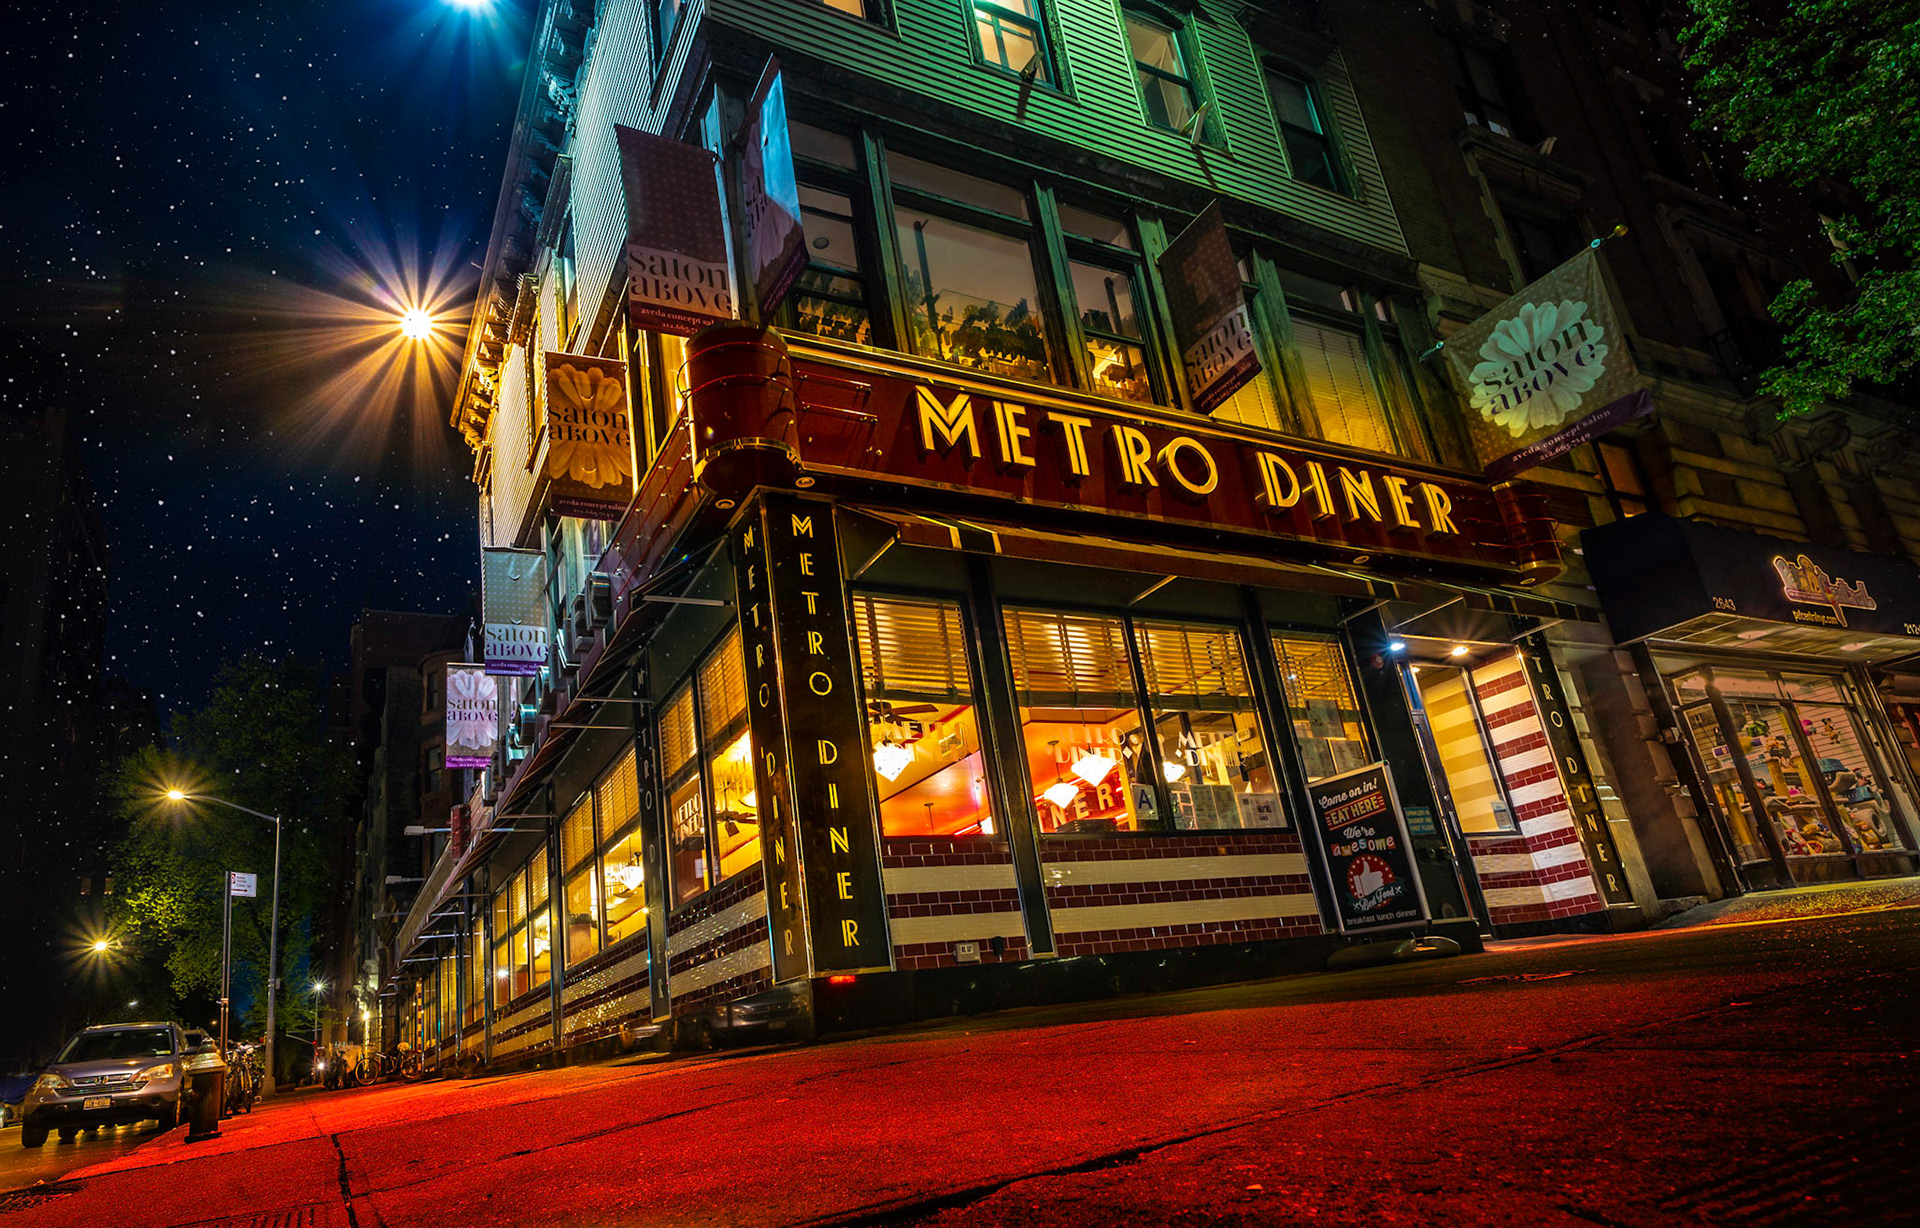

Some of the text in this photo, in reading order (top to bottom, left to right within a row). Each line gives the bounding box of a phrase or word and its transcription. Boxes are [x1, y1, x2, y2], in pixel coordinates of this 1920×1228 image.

[630, 252, 726, 290] salon
[1484, 322, 1588, 396] salon
[549, 407, 627, 431] salon
[1512, 410, 1611, 462] aveda concept salon
[916, 385, 1460, 536] METRO DINER
[1712, 596, 1737, 612] 2643
[486, 626, 546, 644] salon
[447, 699, 496, 711] salon
[743, 525, 793, 956] METRO DINER
[791, 513, 860, 947] METRO DINER
[1517, 615, 1619, 893] ETRO DINER
[1049, 782, 1115, 830] NER
[1138, 788, 1154, 810] A
[1319, 777, 1379, 810] Come on in!
[1330, 796, 1381, 826] EAT HERE
[1343, 825, 1376, 839] We're
[1347, 908, 1417, 926] breakfast lunch dinner
